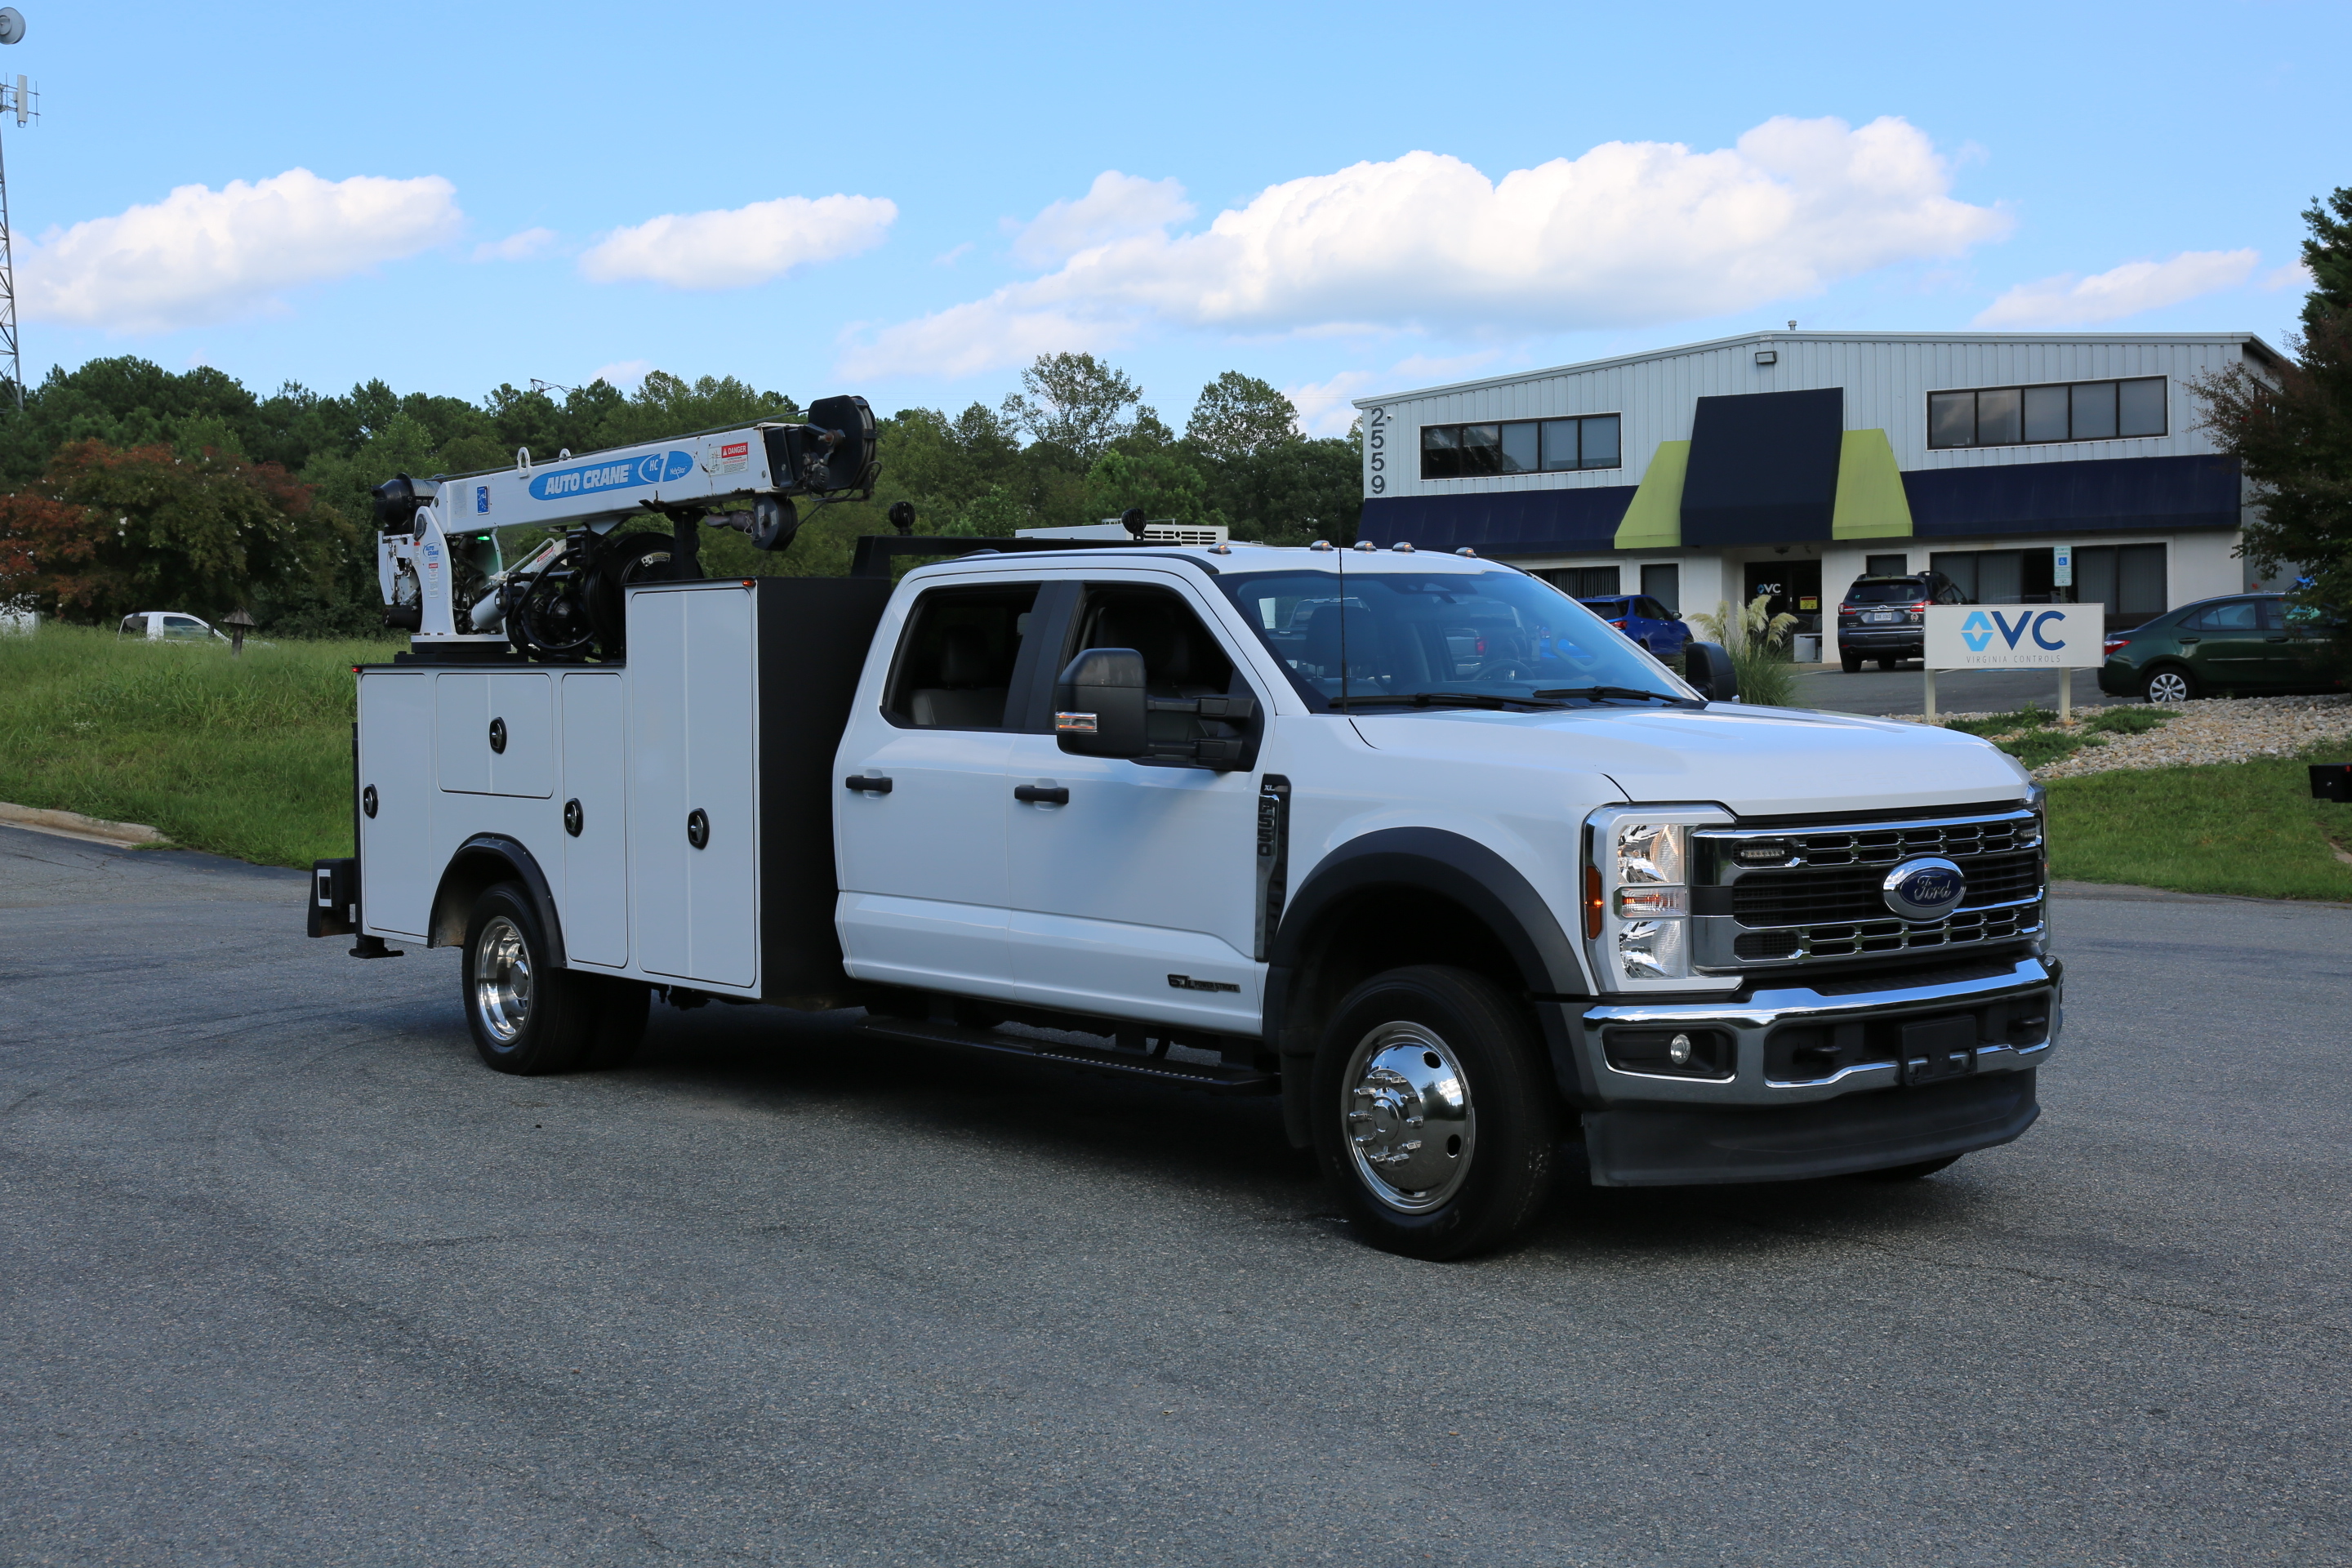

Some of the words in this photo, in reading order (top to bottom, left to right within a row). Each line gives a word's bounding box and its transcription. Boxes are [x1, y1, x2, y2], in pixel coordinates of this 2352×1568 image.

[728, 445, 746, 455] DANGER
[1371, 408, 1385, 494] 2559
[649, 459, 658, 471] HC
[545, 472, 581, 496] AUTO
[1966, 655, 2007, 664] VIRGINIA
[2013, 654, 2060, 663] CONTROLS
[1914, 875, 1951, 901] Ford
[1195, 980, 1214, 989] POWER
[1215, 982, 1238, 991] STROKE
